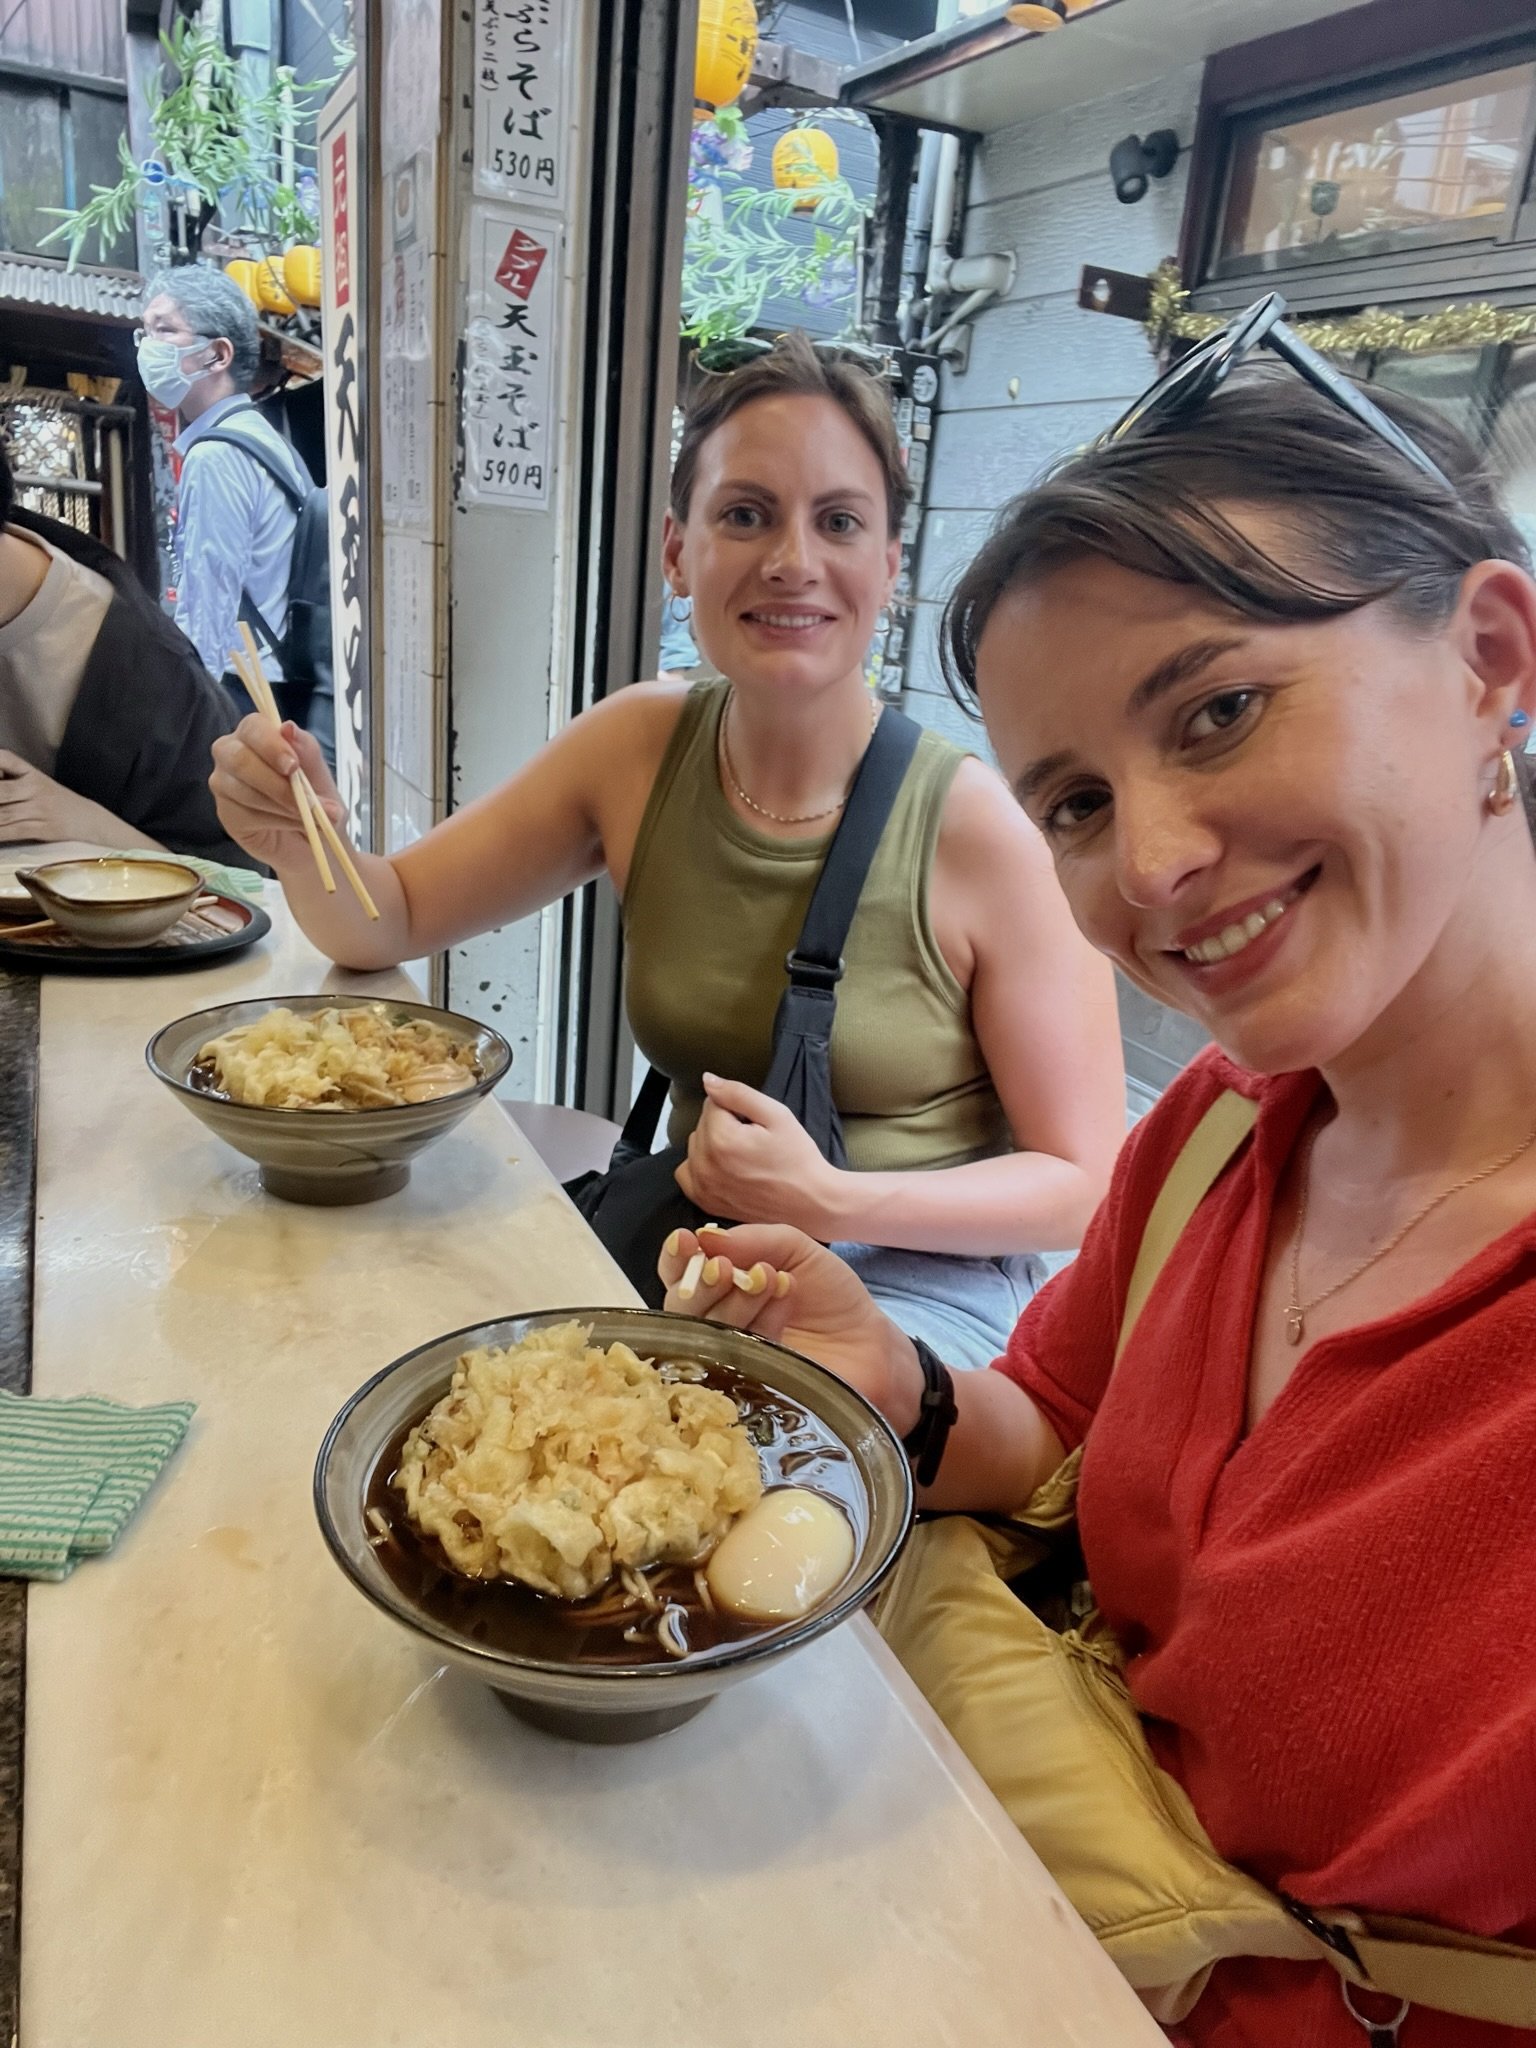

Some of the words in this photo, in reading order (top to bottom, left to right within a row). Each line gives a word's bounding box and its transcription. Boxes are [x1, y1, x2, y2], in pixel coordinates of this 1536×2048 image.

[492, 148, 554, 187] 530円
[493, 302, 540, 451] 天玉そば
[483, 459, 542, 490] 590円
